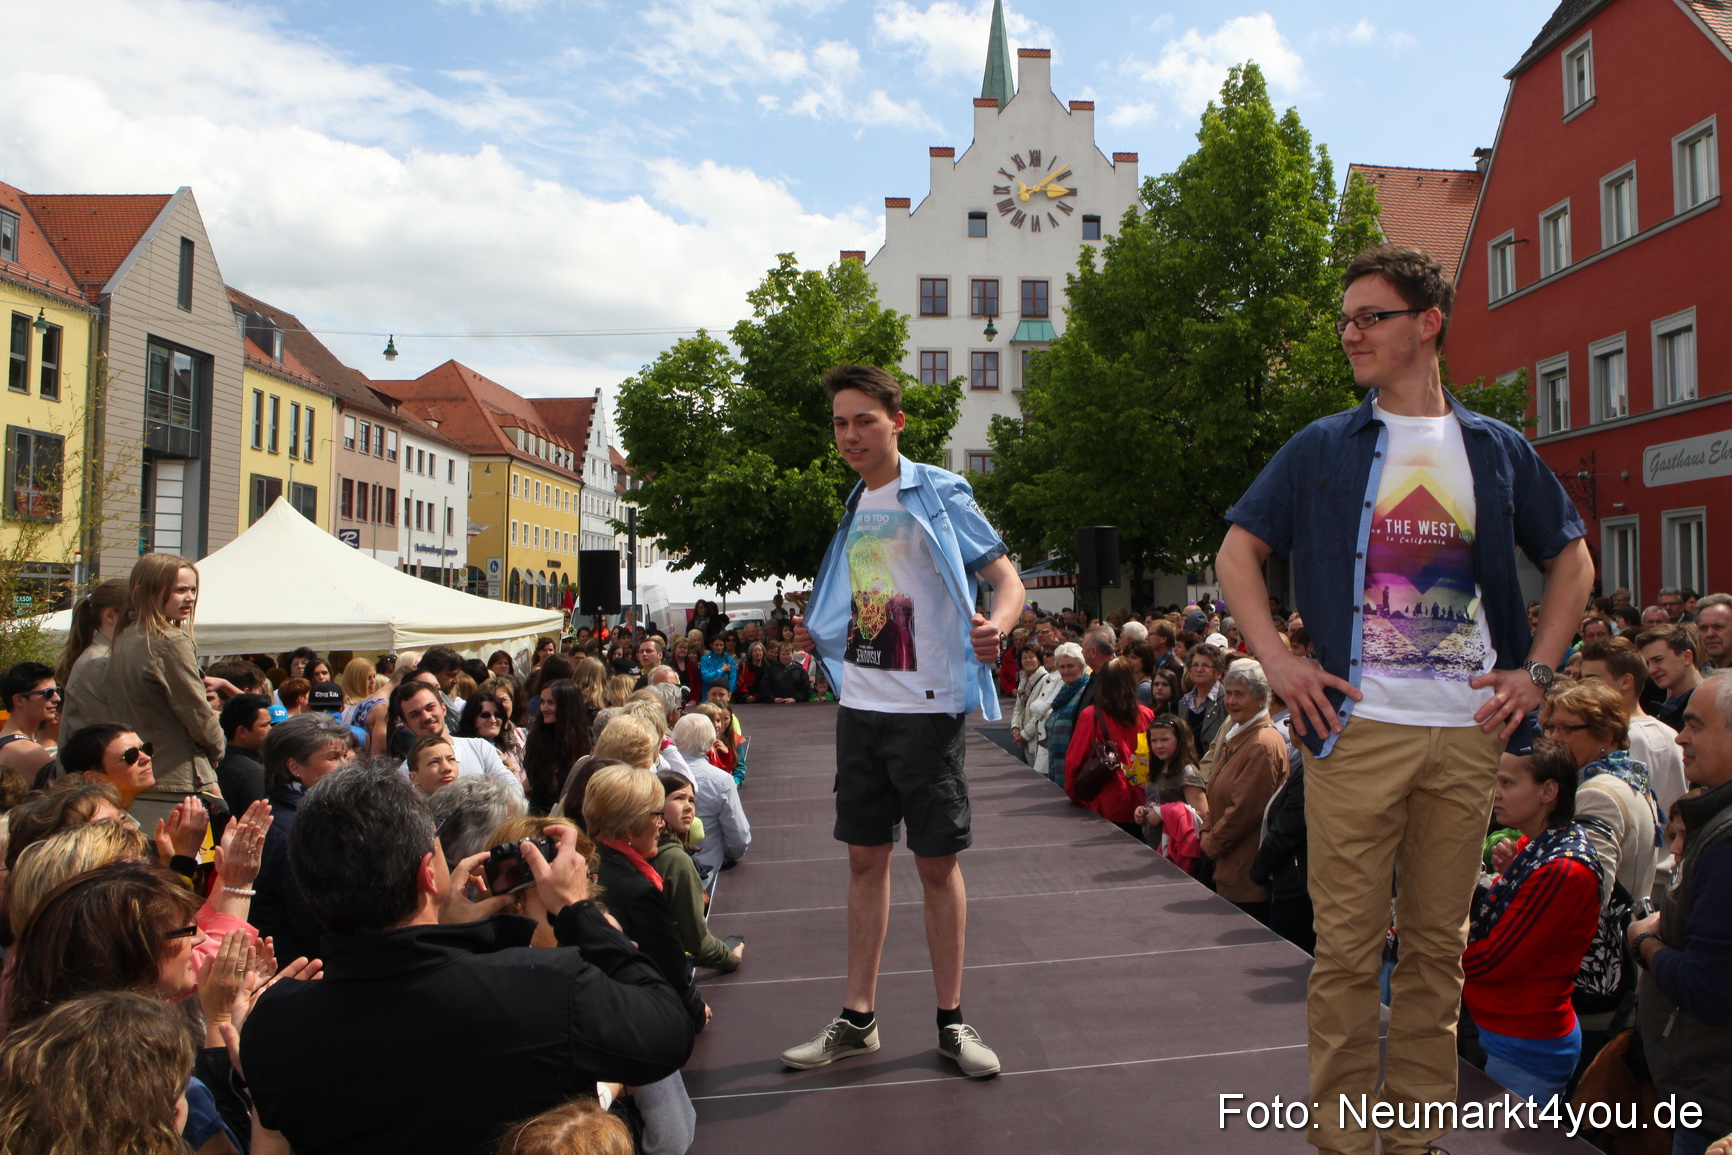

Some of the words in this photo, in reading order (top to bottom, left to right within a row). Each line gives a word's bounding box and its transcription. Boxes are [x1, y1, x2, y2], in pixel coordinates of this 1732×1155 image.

[998, 167, 1015, 181] X
[1649, 447, 1706, 481] Gasthaus
[864, 513, 871, 523] IS
[871, 513, 890, 523] TOO
[1385, 518, 1412, 535] THE
[1418, 520, 1456, 538] WEST
[1400, 536, 1446, 545] California
[329, 690, 339, 698] Life
